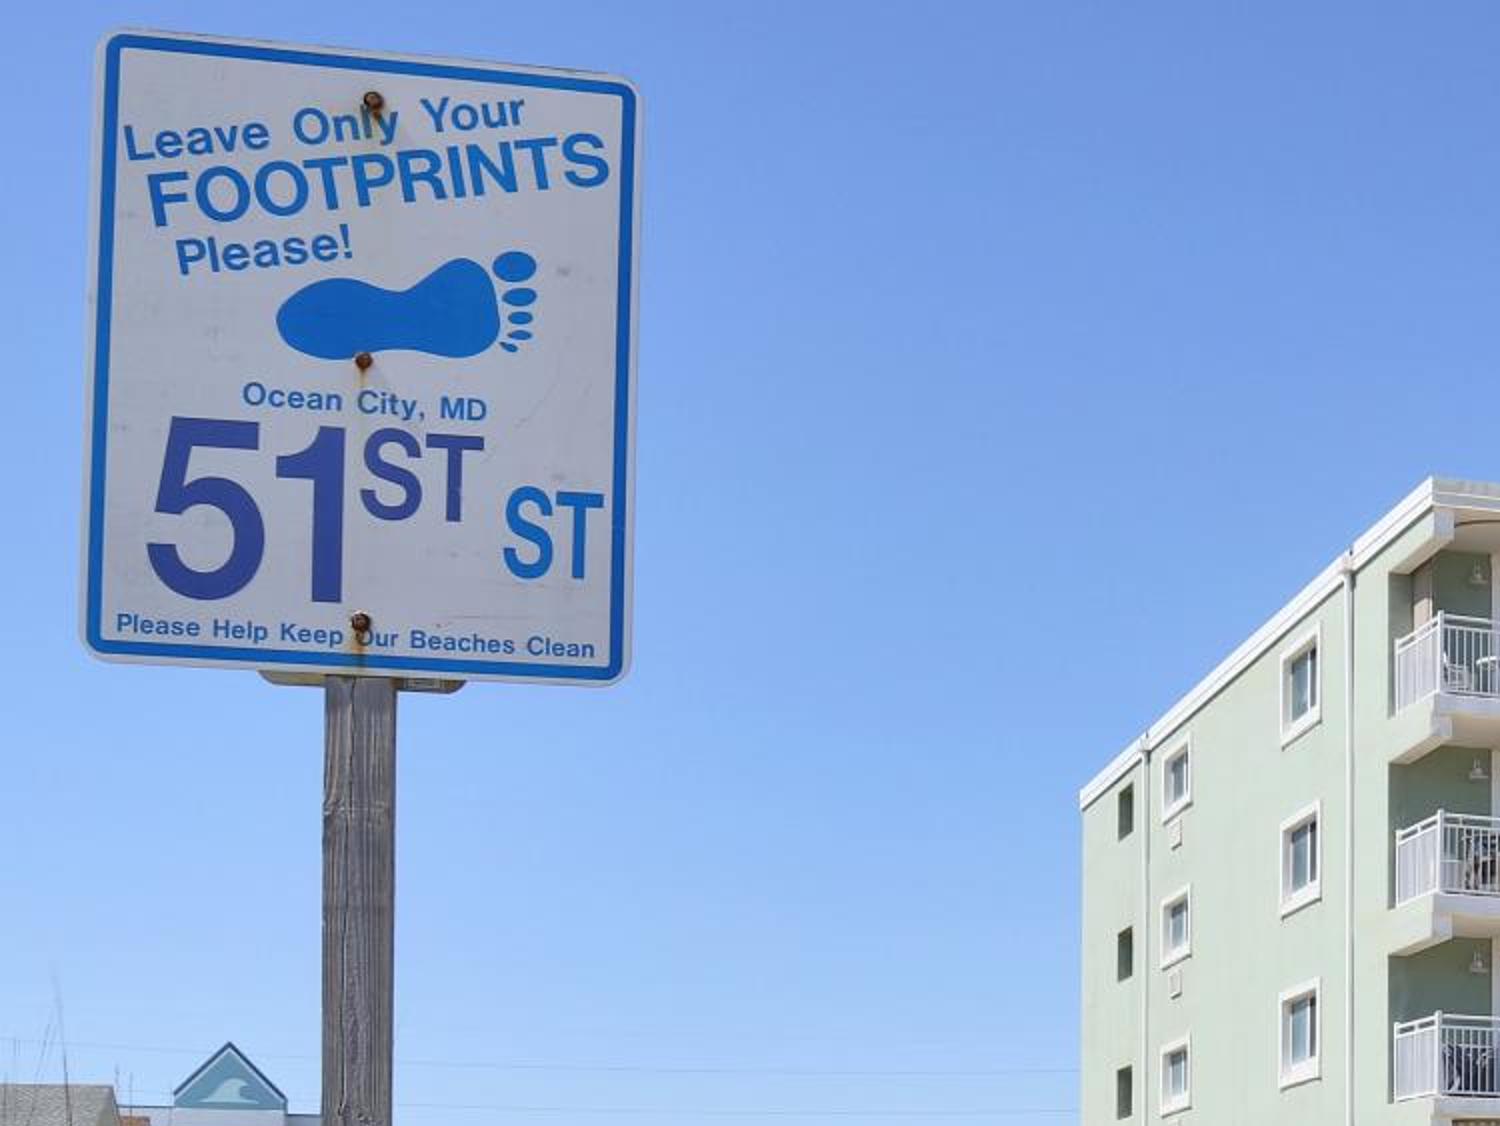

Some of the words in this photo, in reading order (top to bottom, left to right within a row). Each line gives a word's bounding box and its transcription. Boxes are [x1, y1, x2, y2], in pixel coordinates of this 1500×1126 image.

[123, 119, 270, 162] Leave
[292, 105, 398, 146] Only
[420, 95, 526, 134] Your
[146, 132, 611, 228] FOOTPRINTS
[175, 223, 353, 277] Please!
[242, 381, 343, 413] Ocean
[357, 389, 426, 422] City,
[439, 396, 488, 423] MD
[503, 485, 604, 580] ST
[115, 612, 201, 639] Please
[212, 619, 269, 646] Help
[280, 623, 344, 648] Keep
[410, 630, 516, 656] Beaches
[526, 636, 597, 659] Clean
